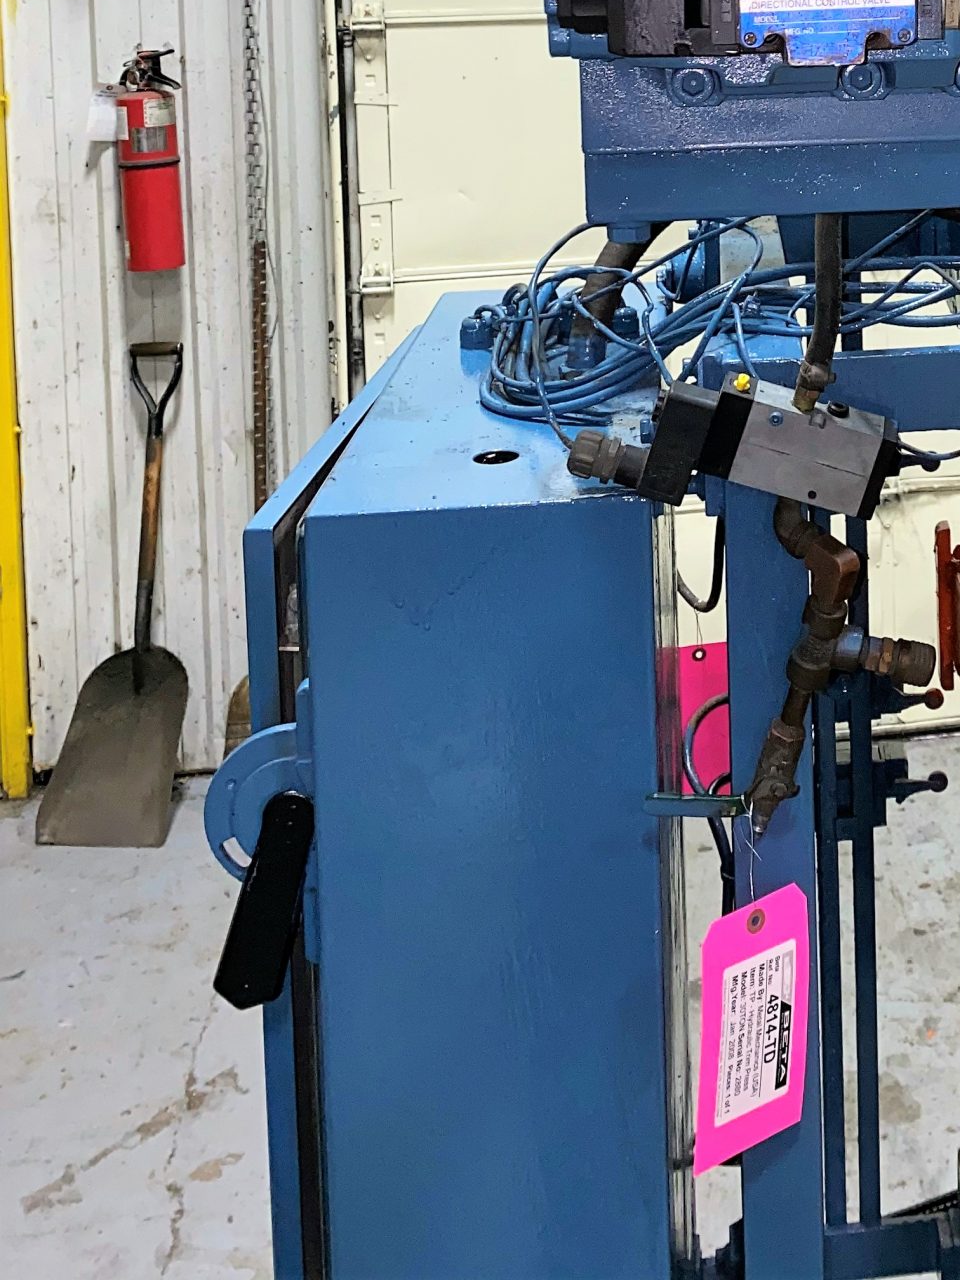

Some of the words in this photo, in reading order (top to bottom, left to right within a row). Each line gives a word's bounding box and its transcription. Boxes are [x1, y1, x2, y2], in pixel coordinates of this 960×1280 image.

[752, 0, 813, 9] DIRECTIONAL
[745, 1011, 755, 1047] Hydraulic
[764, 994, 779, 1063] 4814-TD
[779, 1010, 790, 1083] BETA
